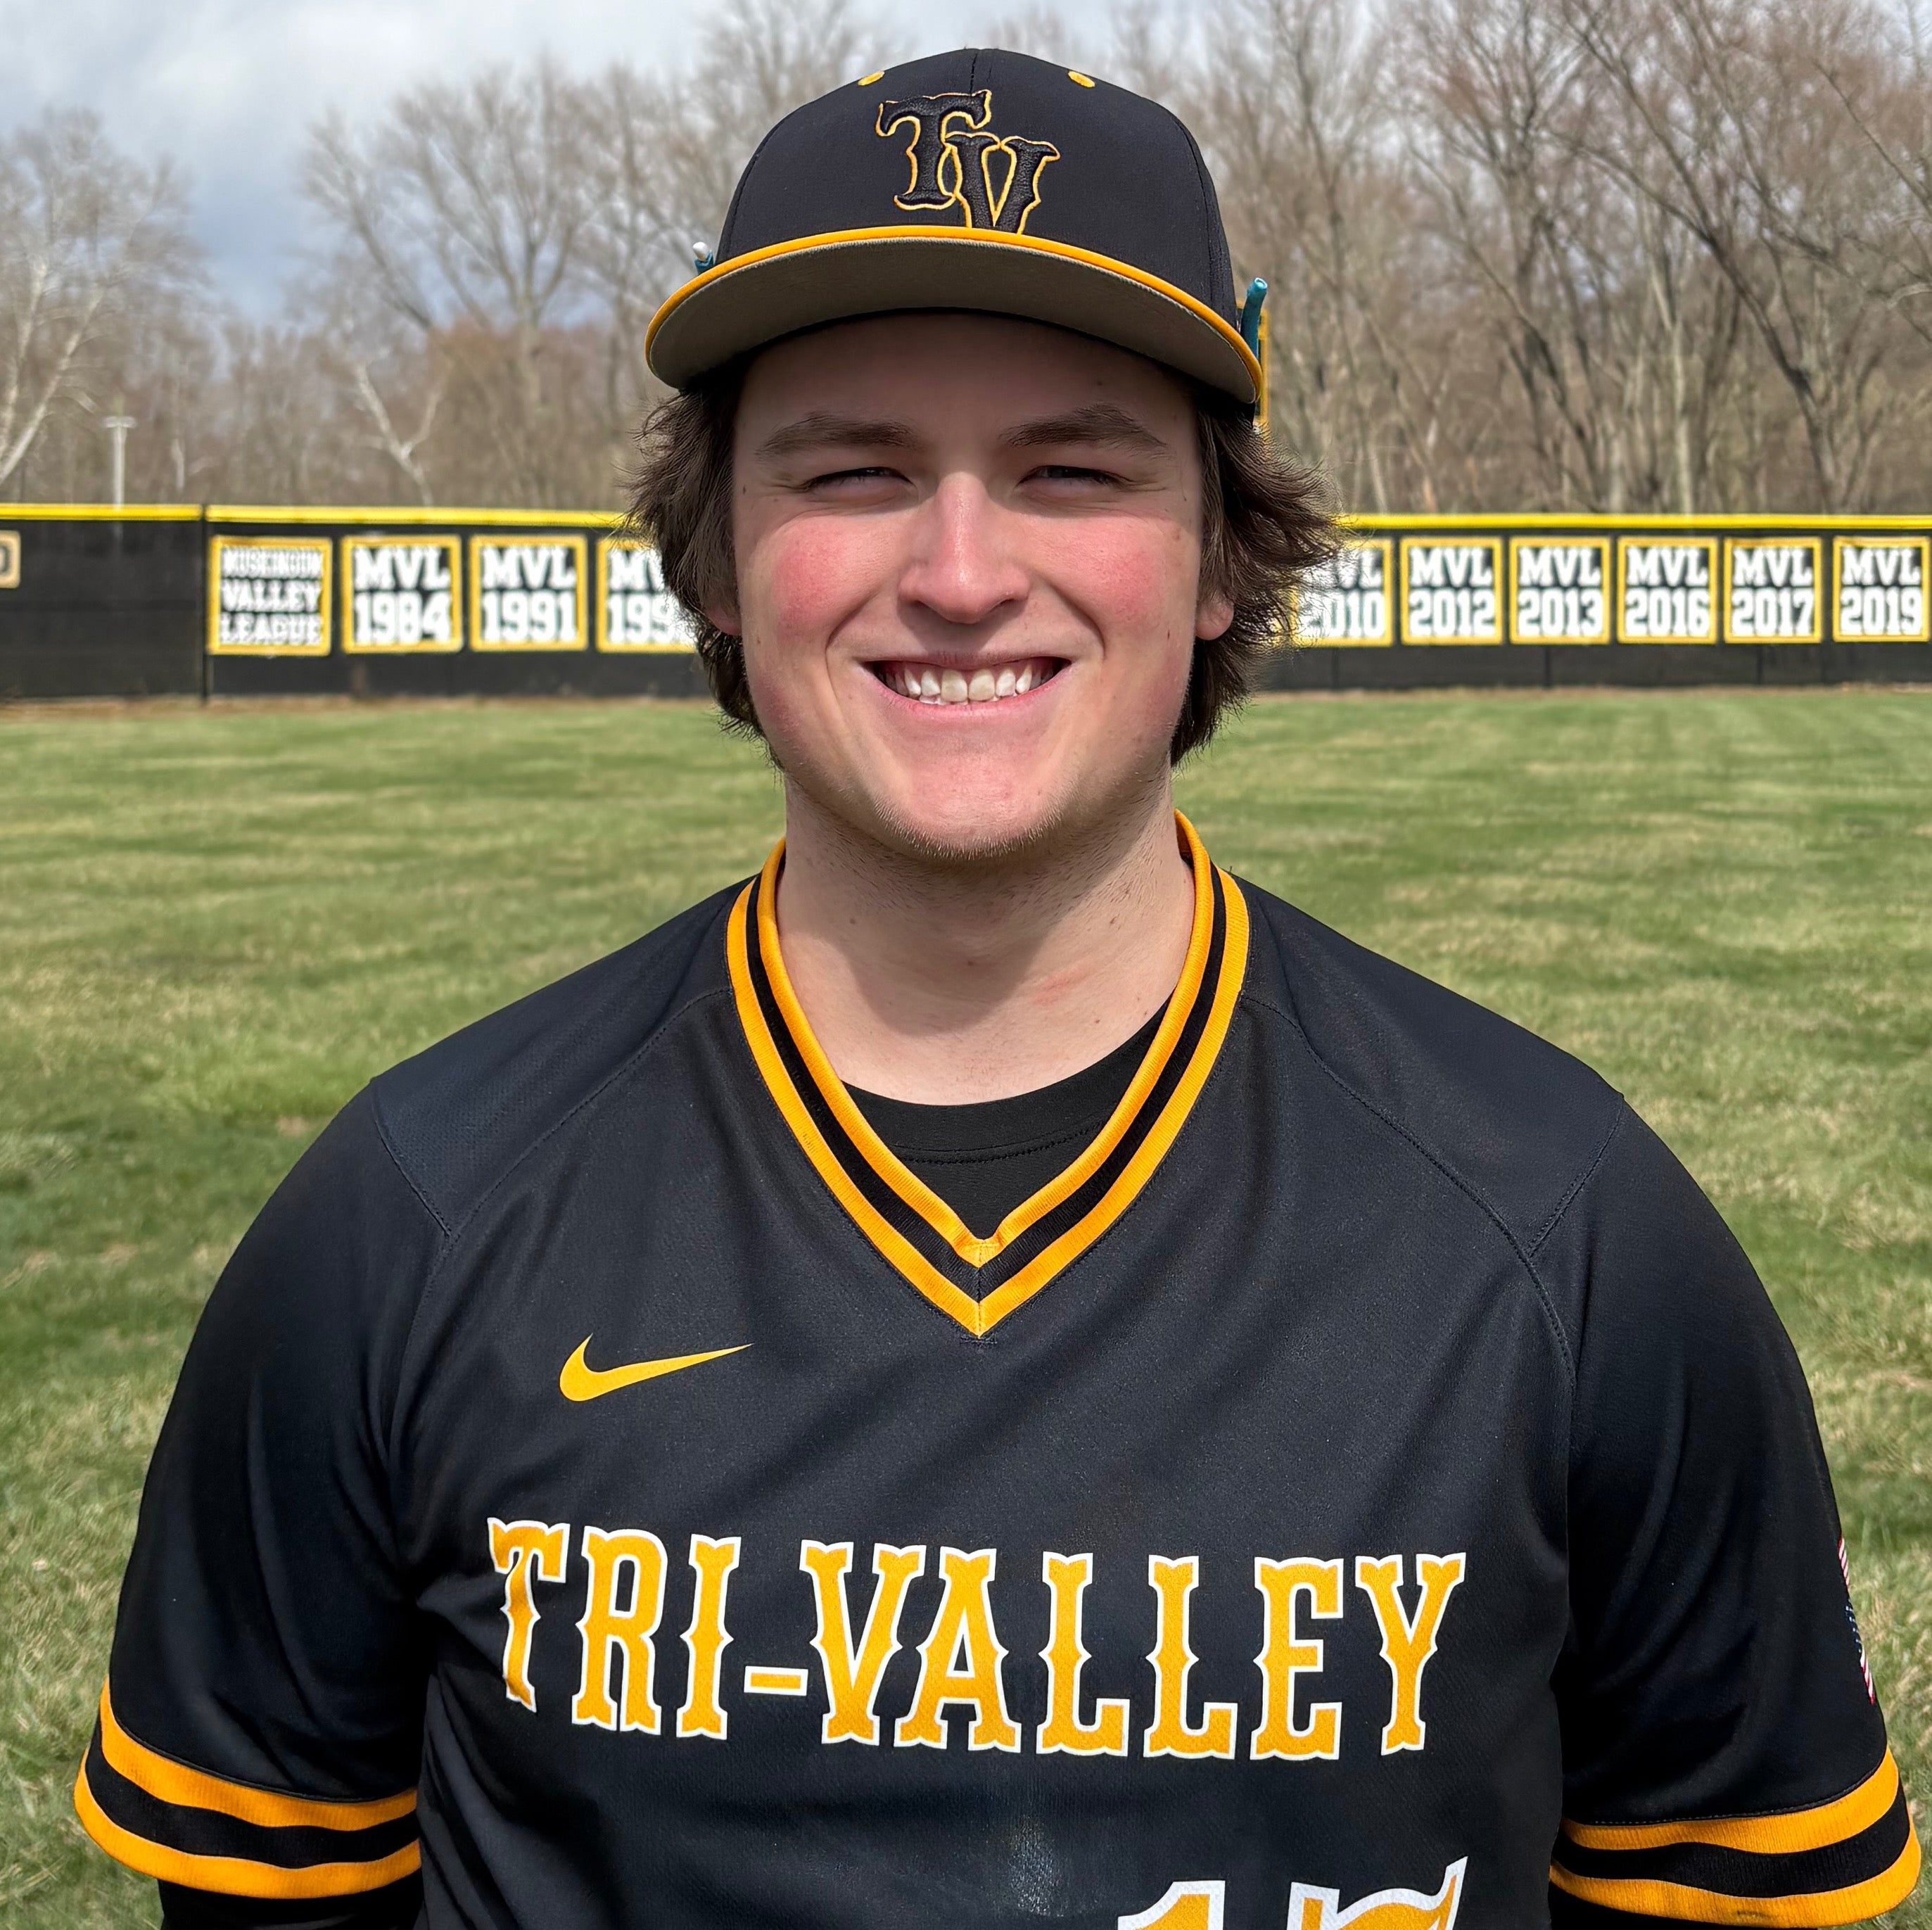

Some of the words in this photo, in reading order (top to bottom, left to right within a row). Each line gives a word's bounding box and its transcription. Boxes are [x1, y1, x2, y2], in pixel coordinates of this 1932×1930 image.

[876, 89, 1060, 236] TV
[354, 546, 450, 590] MVL
[481, 546, 576, 590] MVL
[609, 550, 664, 590] MV
[1409, 547, 1493, 587] MVL
[1518, 547, 1601, 587] MVL
[1626, 547, 1708, 587] MVL
[1733, 547, 1812, 587] MVL
[1841, 547, 1921, 587] MVL
[222, 578, 322, 611] VALLEY
[1409, 588, 1494, 636] 2012
[1518, 588, 1603, 636] 2013
[1625, 588, 1710, 636] 2016
[1731, 588, 1814, 636] 2017
[1840, 588, 1922, 636] 2019
[220, 613, 322, 645] LEAGUE
[354, 592, 451, 645] 1984
[481, 591, 577, 645] 1991
[609, 595, 695, 644] 199
[487, 1517, 1466, 1760] TRI-VALLEY
